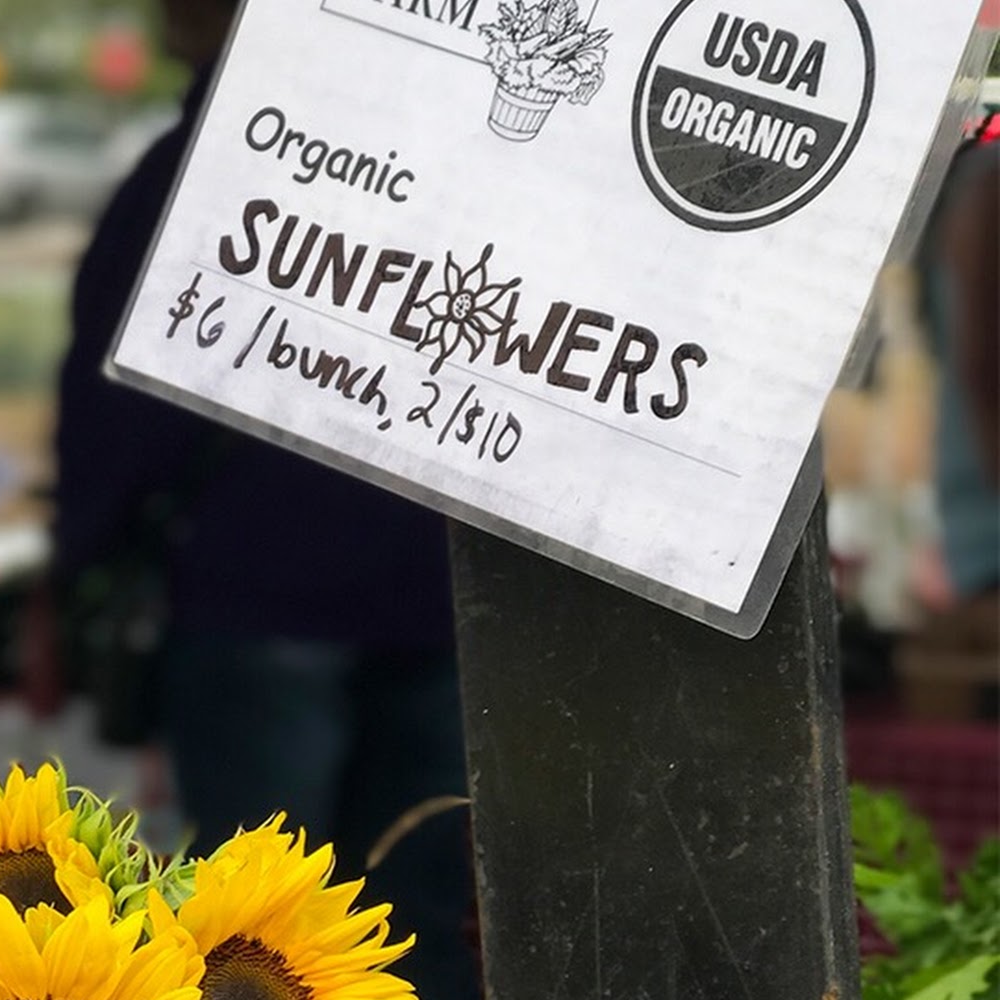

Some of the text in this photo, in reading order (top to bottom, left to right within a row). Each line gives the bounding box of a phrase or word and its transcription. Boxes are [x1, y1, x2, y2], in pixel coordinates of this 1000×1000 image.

[703, 11, 827, 98] USDA
[244, 106, 416, 203] Organic
[660, 86, 818, 170] ORGANIC
[166, 272, 226, 349] $6
[406, 381, 523, 463] 2/$10
